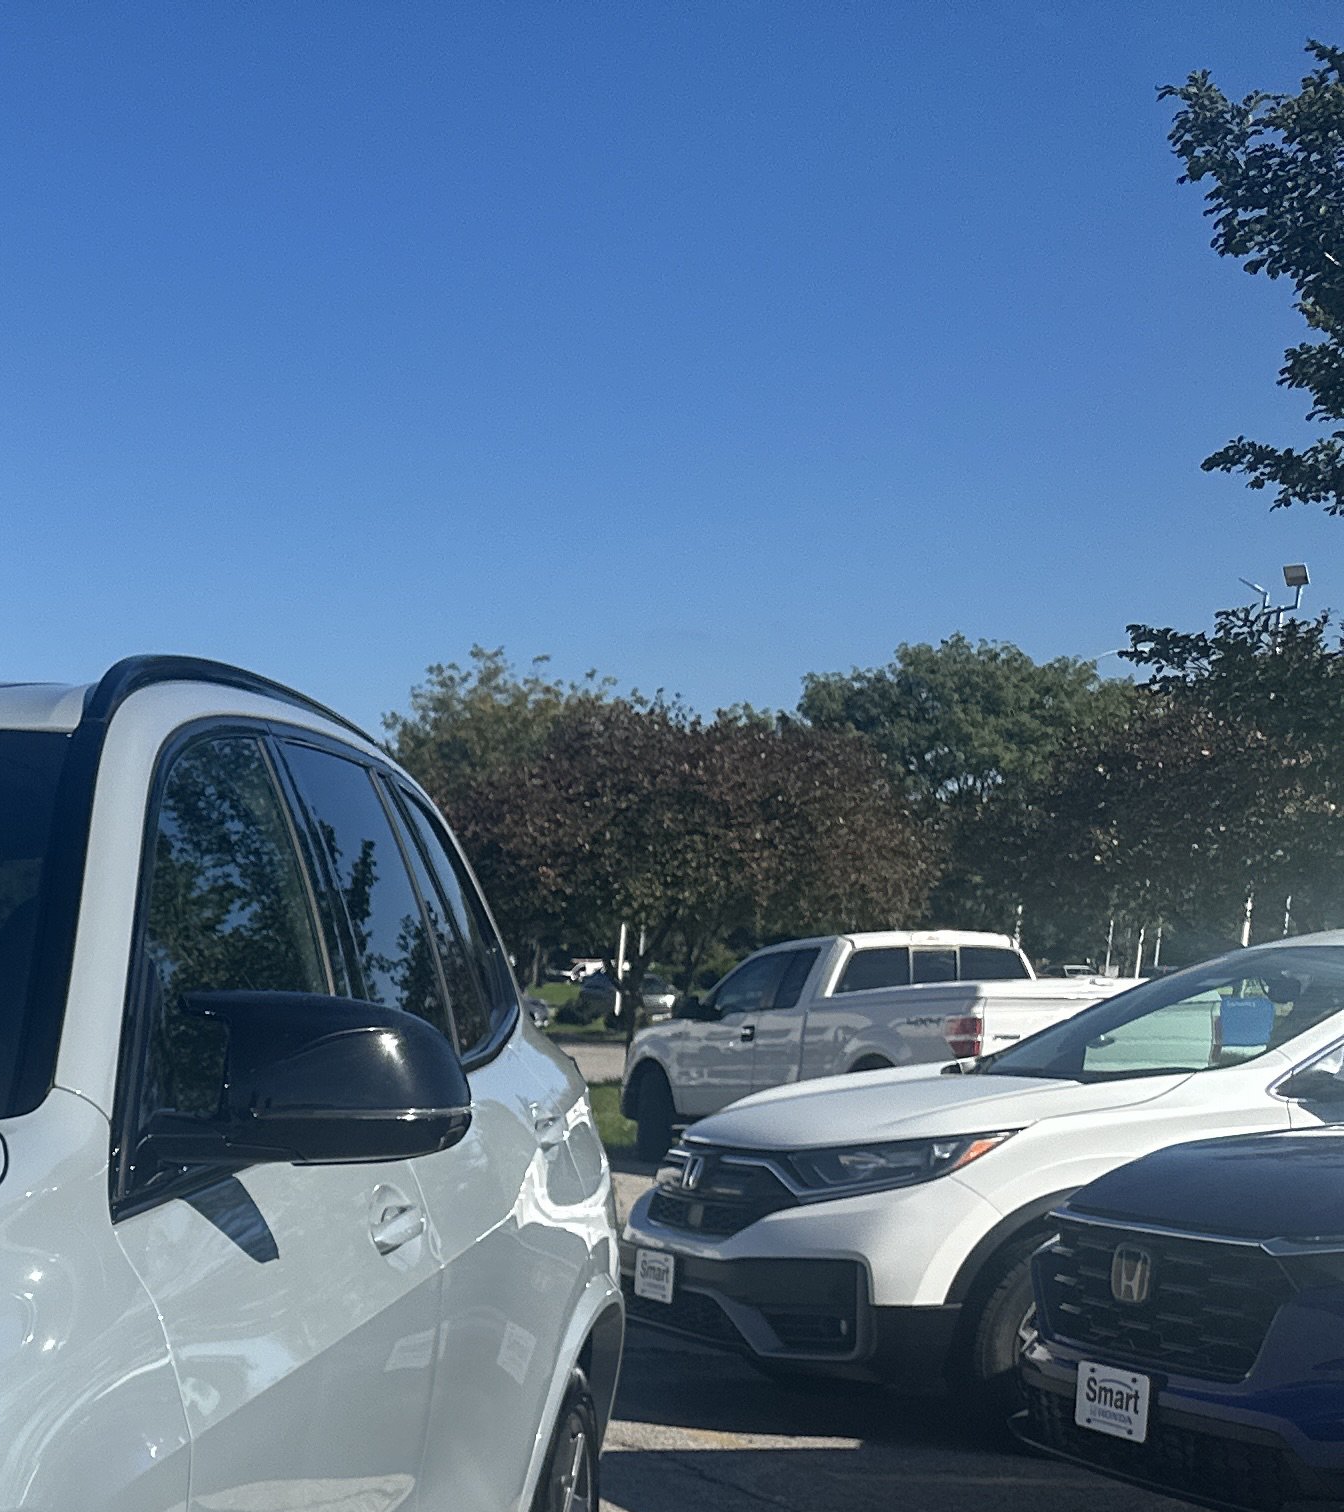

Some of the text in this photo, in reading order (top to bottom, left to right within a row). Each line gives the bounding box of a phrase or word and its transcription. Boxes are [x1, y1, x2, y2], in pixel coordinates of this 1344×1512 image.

[640, 1259, 670, 1284] Smart
[1086, 1376, 1140, 1415] Smart
[1098, 1407, 1133, 1426] HONDA
